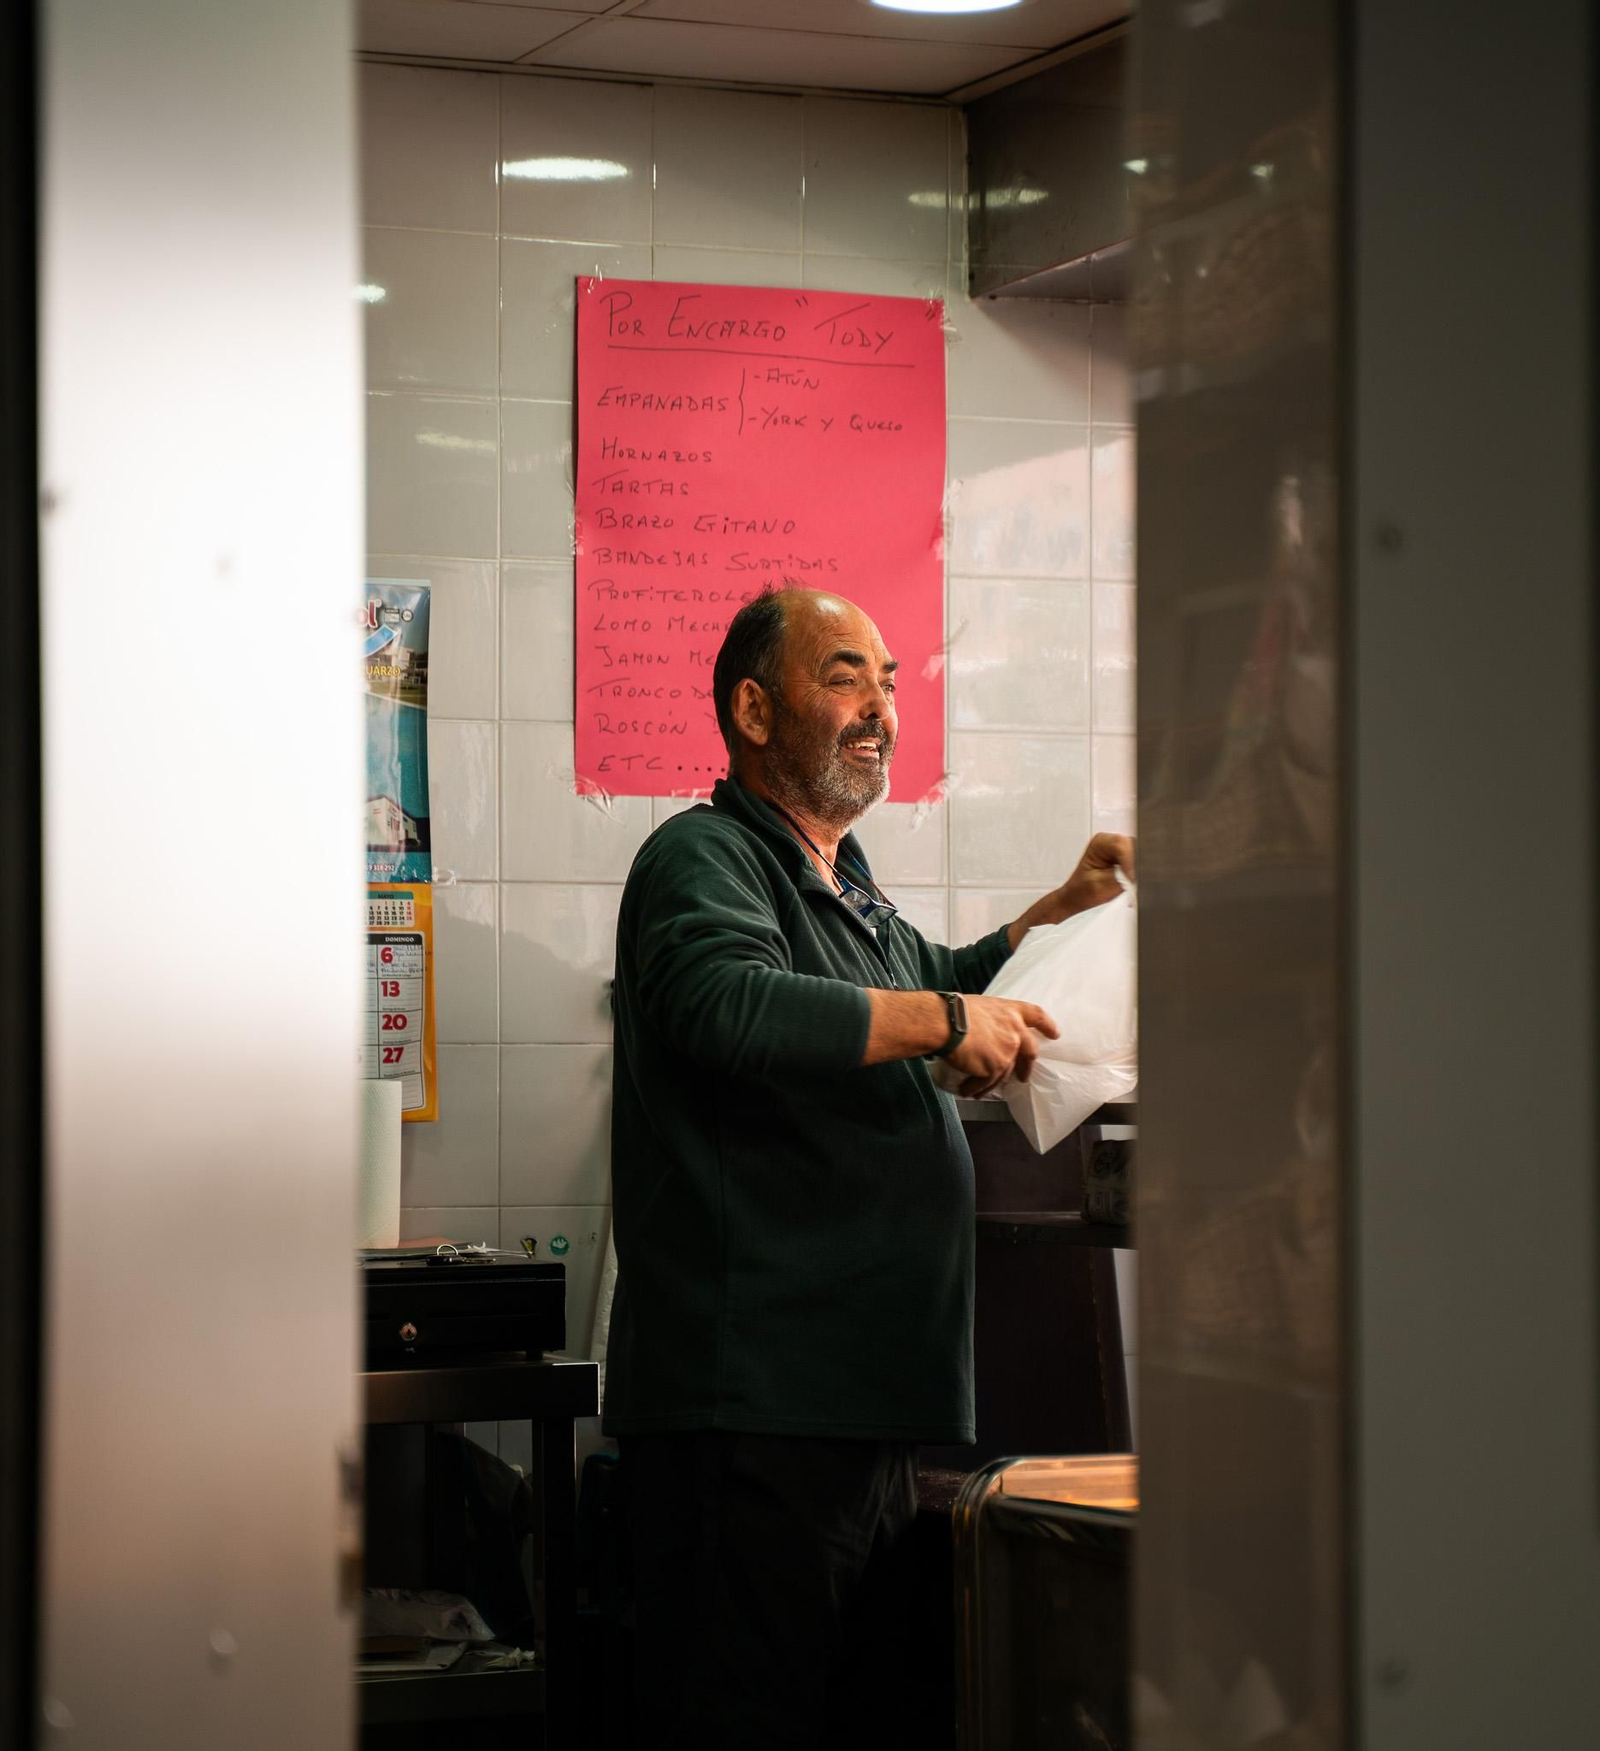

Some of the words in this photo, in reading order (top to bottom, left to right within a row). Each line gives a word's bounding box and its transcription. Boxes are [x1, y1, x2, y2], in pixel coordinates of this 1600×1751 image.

[600, 291, 644, 337] POR
[668, 295, 786, 341] ENCARGO
[597, 385, 729, 411] EMPANADAS
[602, 437, 712, 462] HORNAZOS
[592, 469, 689, 496] TARTAS
[595, 507, 674, 529] BRAZO
[594, 613, 651, 632] LOMO
[594, 646, 669, 668] JAMON
[587, 677, 681, 699] TRONCO
[381, 947, 394, 964] 6
[381, 981, 401, 998] 13
[382, 1014, 407, 1030] 20
[382, 1046, 404, 1063] 27
